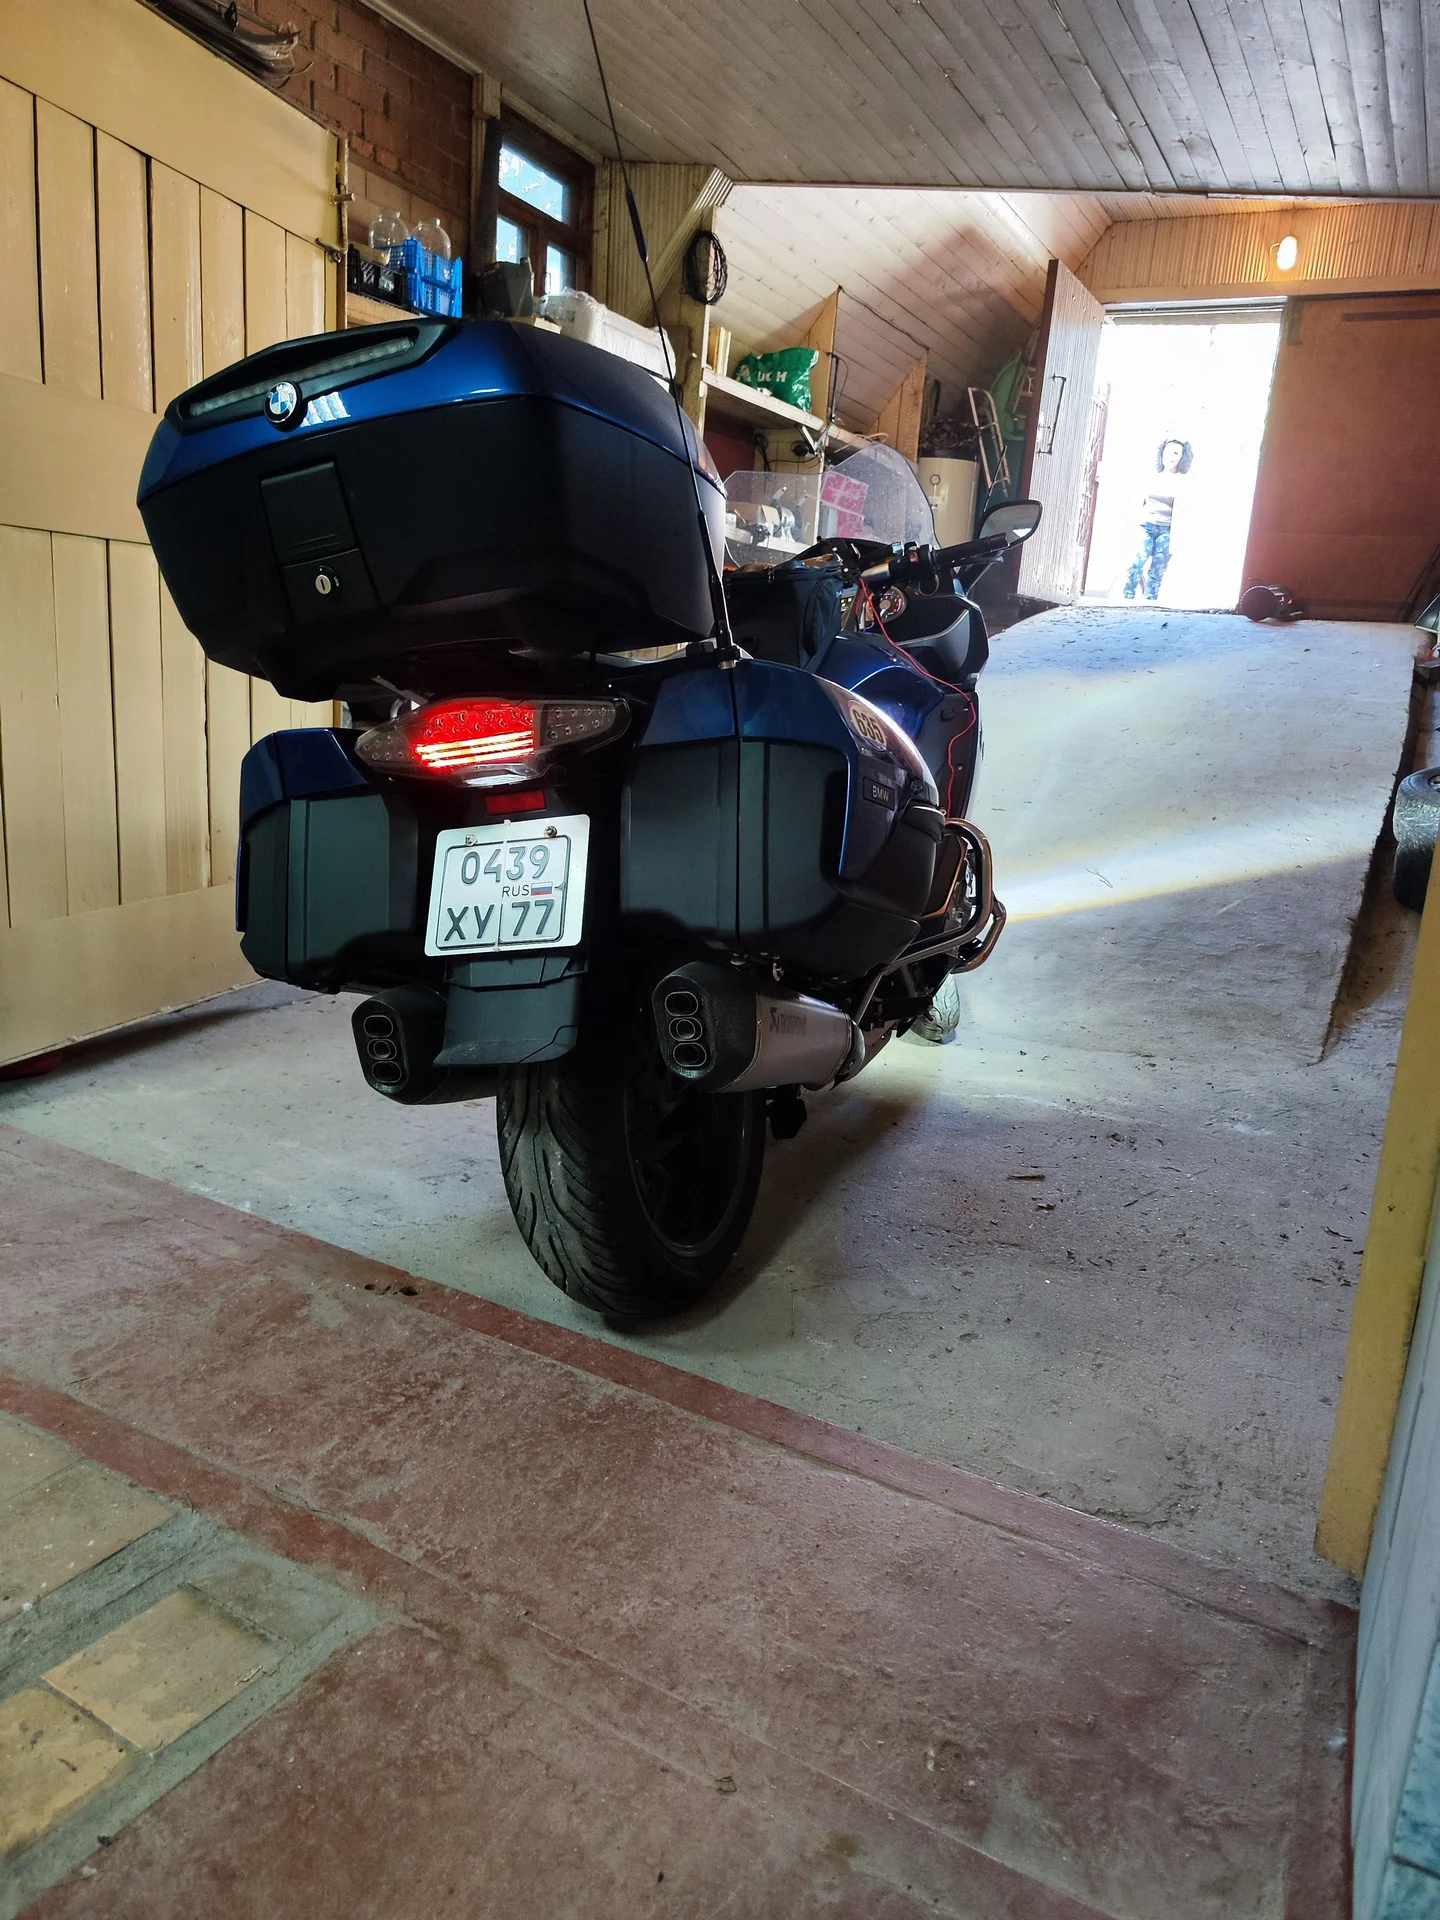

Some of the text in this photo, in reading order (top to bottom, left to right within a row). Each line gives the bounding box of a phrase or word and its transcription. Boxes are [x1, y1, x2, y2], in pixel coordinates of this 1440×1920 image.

[852, 709, 885, 744] 635
[872, 785, 889, 802] BMW
[461, 845, 550, 885] 0439
[502, 884, 530, 898] RUS
[511, 899, 555, 937] 77
